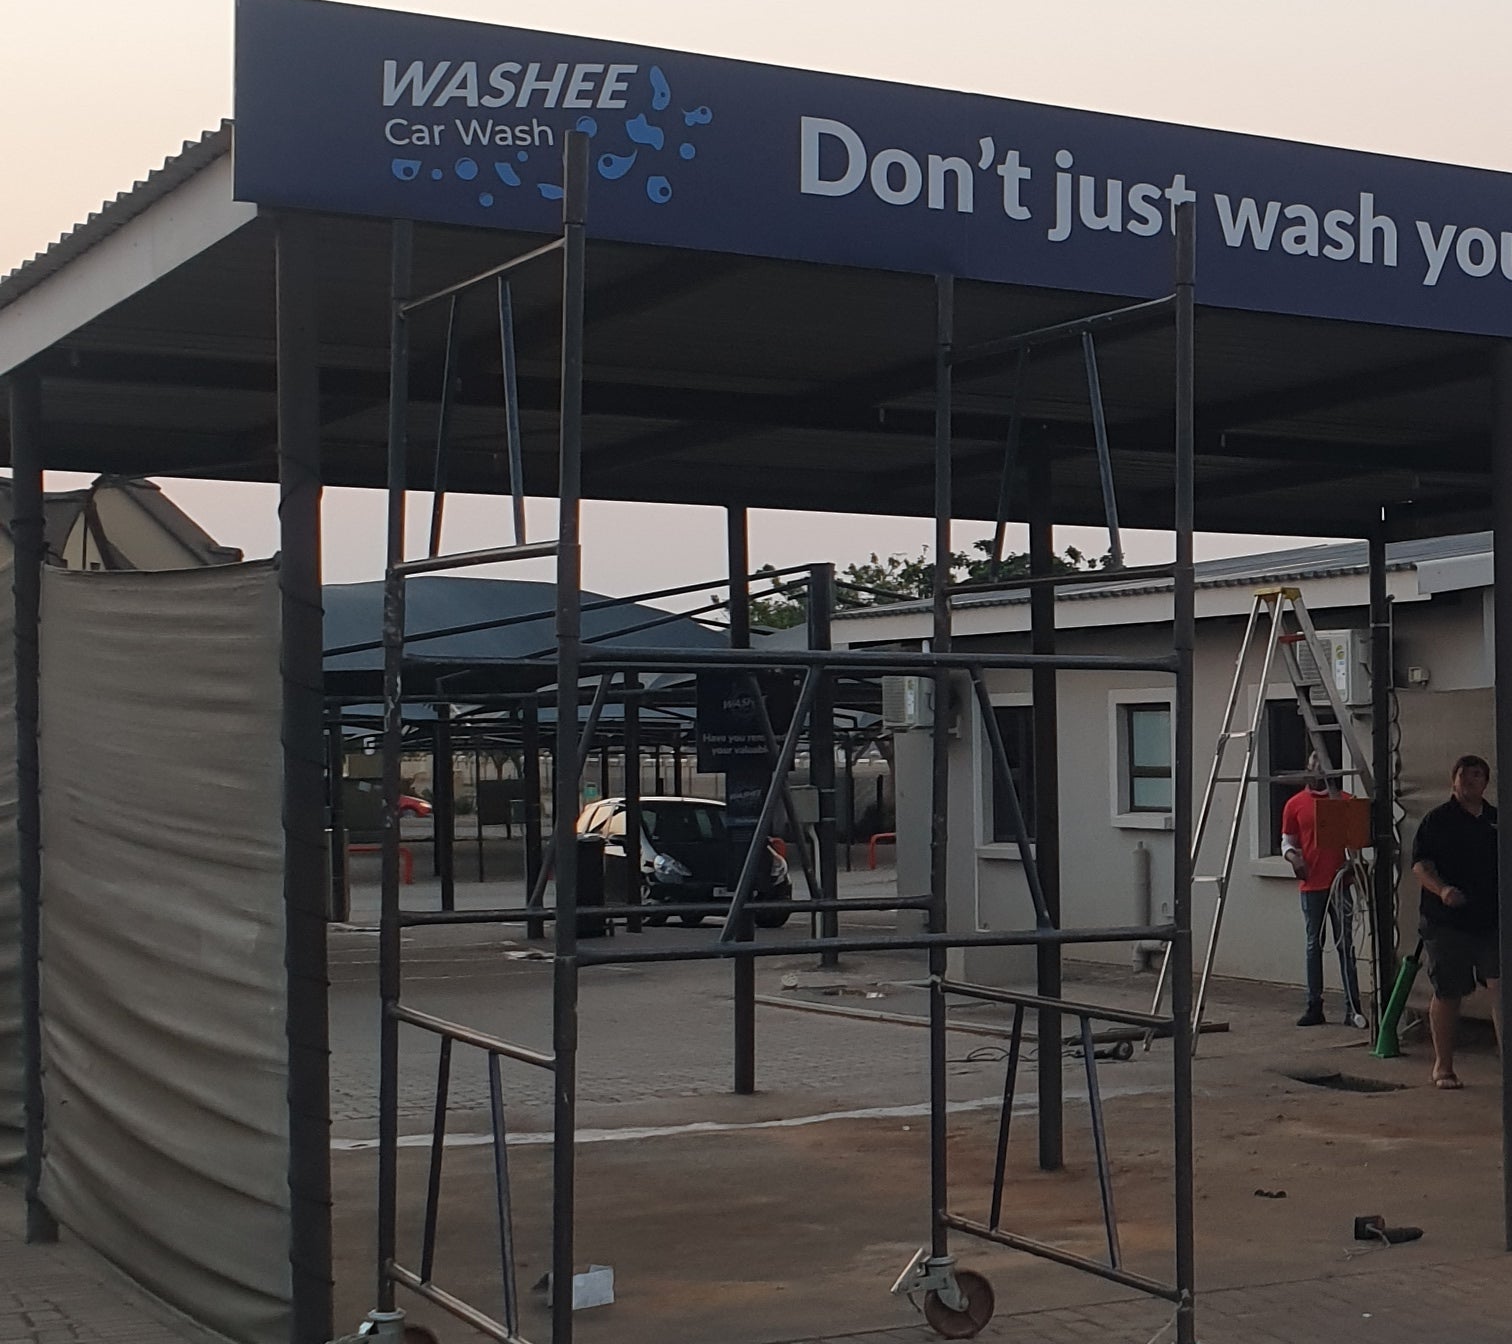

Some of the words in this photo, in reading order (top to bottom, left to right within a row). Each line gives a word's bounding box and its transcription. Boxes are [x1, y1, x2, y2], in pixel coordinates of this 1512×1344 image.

[382, 60, 638, 109] WASHEE
[385, 118, 444, 147] Car
[455, 118, 554, 147] Wash
[1214, 192, 1398, 267] wash
